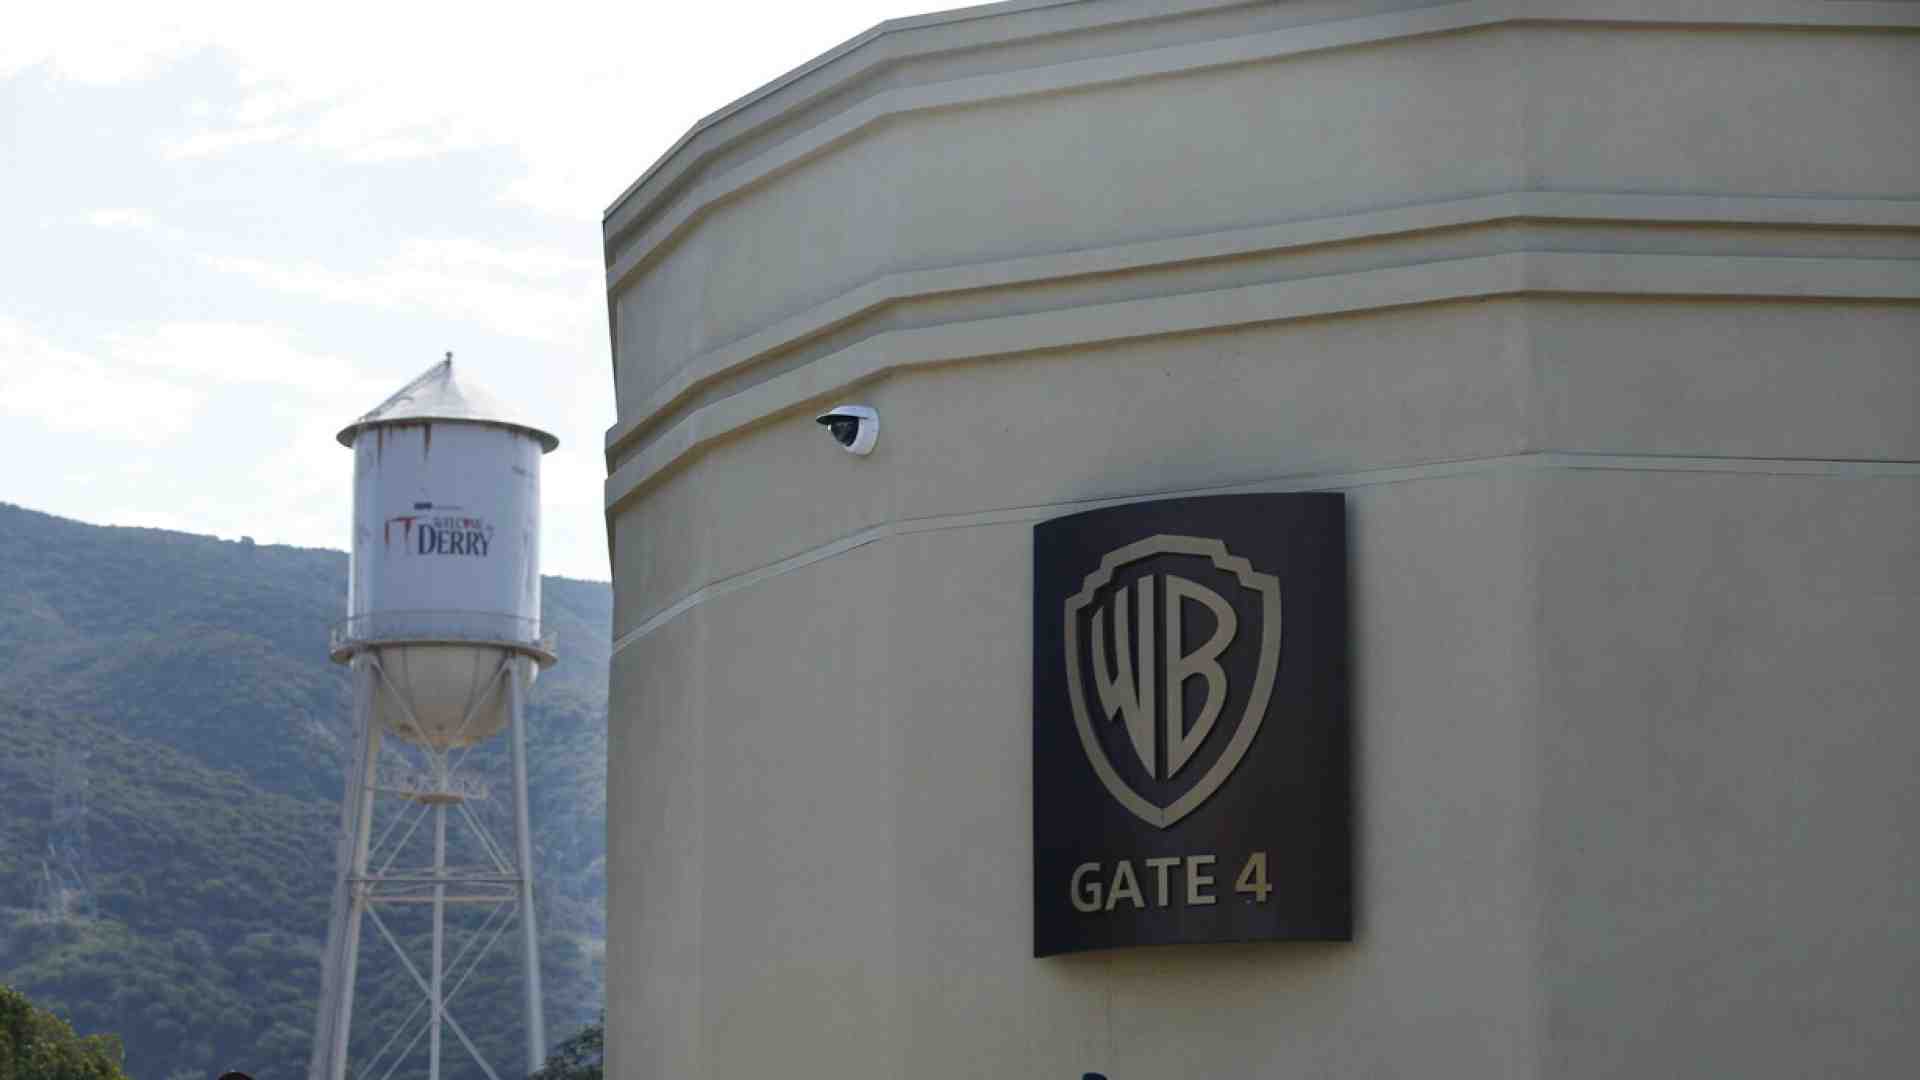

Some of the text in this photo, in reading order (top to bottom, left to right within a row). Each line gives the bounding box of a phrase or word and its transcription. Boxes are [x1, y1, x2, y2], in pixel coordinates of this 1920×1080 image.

[418, 524, 493, 556] DERRY
[1091, 574, 1238, 780] WB
[1070, 852, 1273, 912] GATE 4
